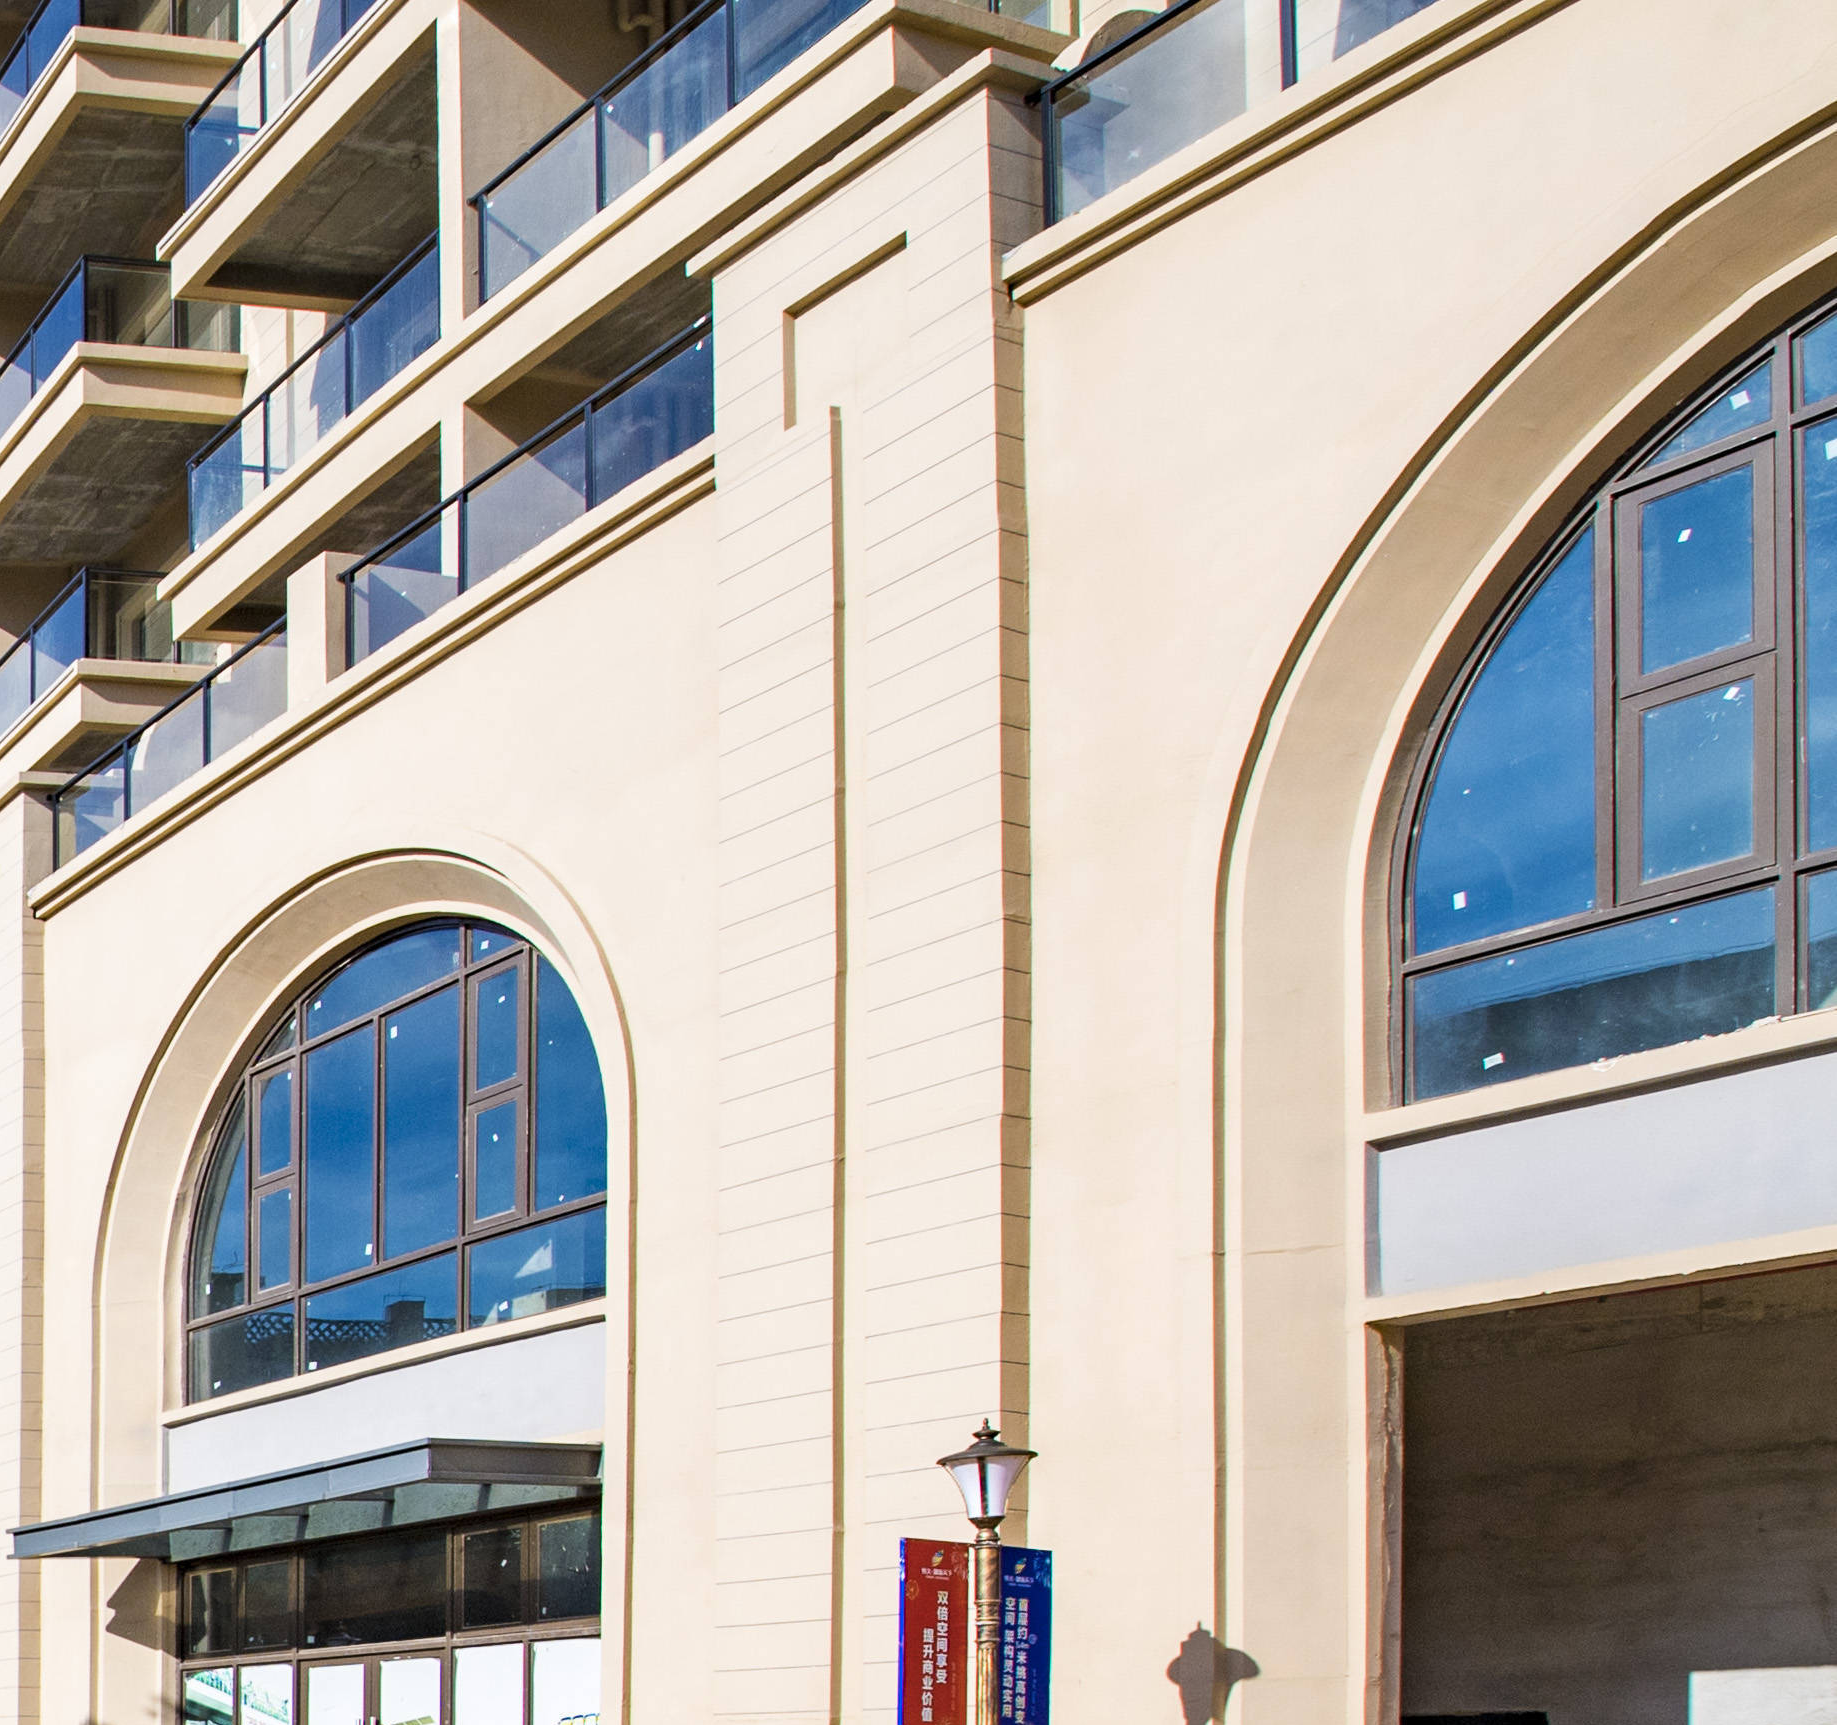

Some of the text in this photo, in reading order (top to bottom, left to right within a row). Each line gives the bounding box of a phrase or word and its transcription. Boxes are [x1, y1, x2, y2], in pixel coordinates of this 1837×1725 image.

[921, 1629, 934, 1722] 提升商业价值
[936, 1591, 949, 1684] 双倍空间享受
